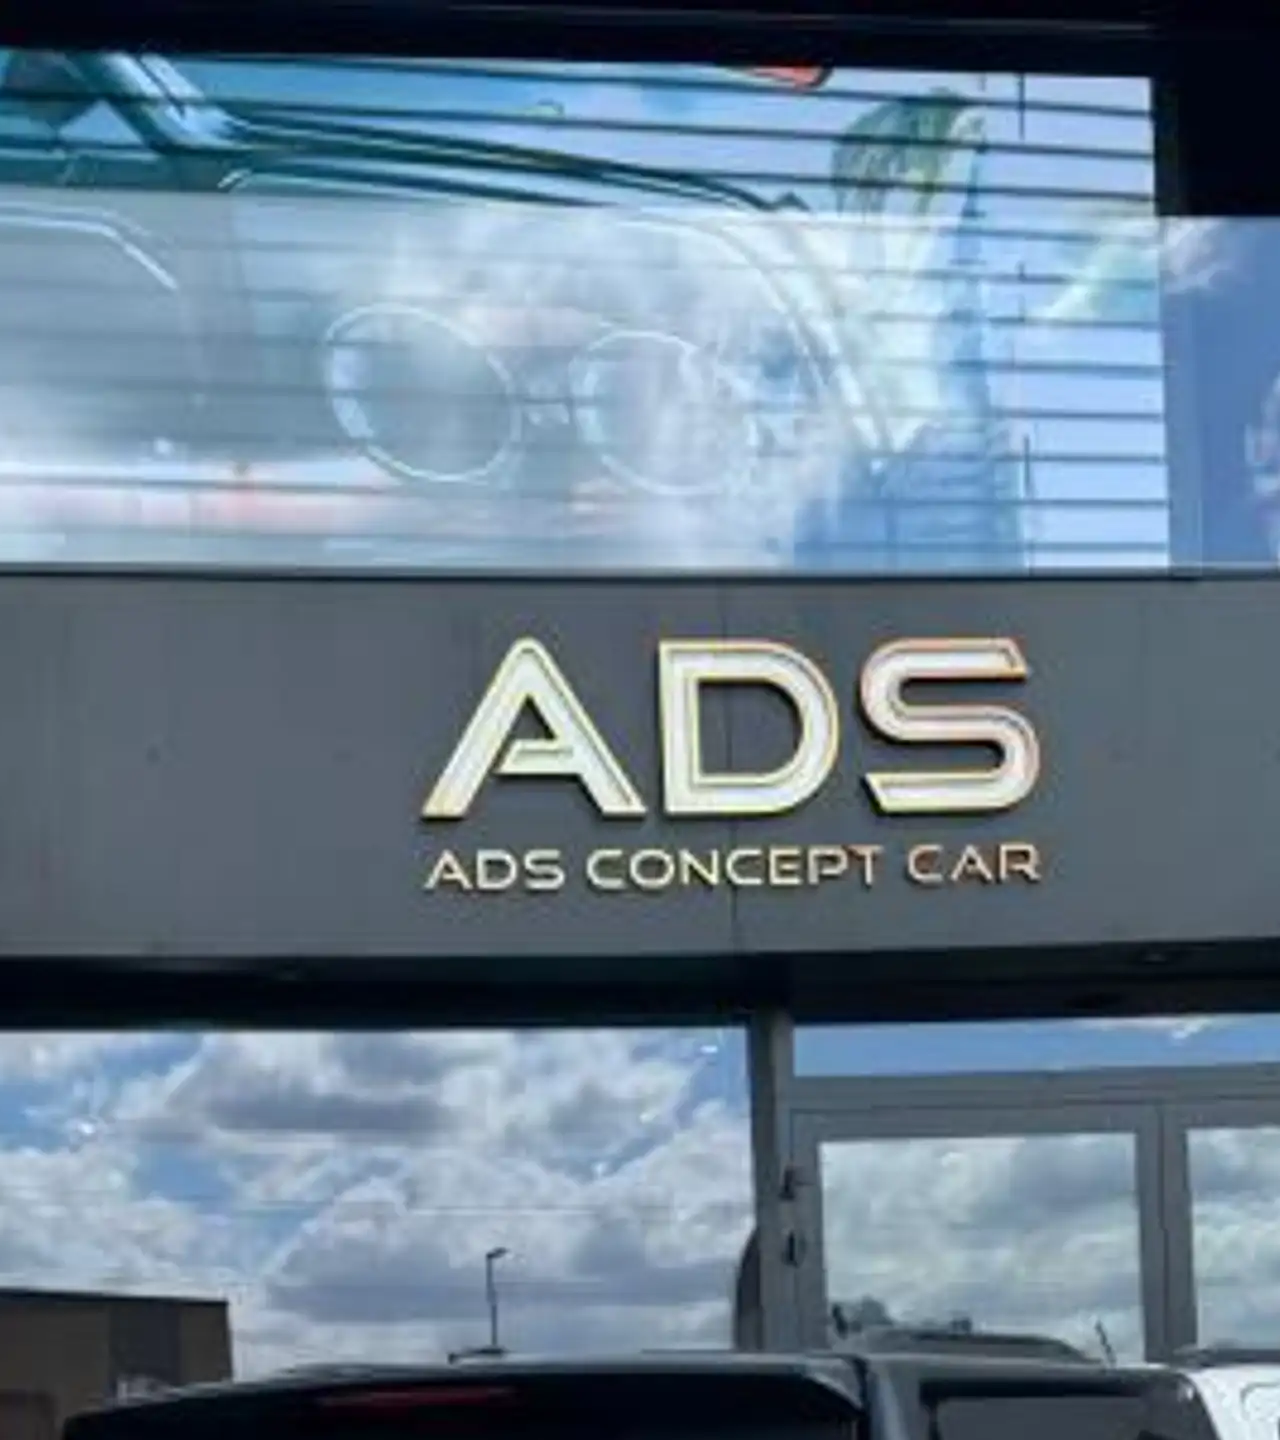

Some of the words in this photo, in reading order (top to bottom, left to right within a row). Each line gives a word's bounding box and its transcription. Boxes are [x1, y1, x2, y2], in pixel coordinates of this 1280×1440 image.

[422, 637, 1040, 815] ADS
[424, 848, 566, 891] ADS
[585, 846, 882, 889] CONCEPT
[906, 843, 1041, 884] CAR
